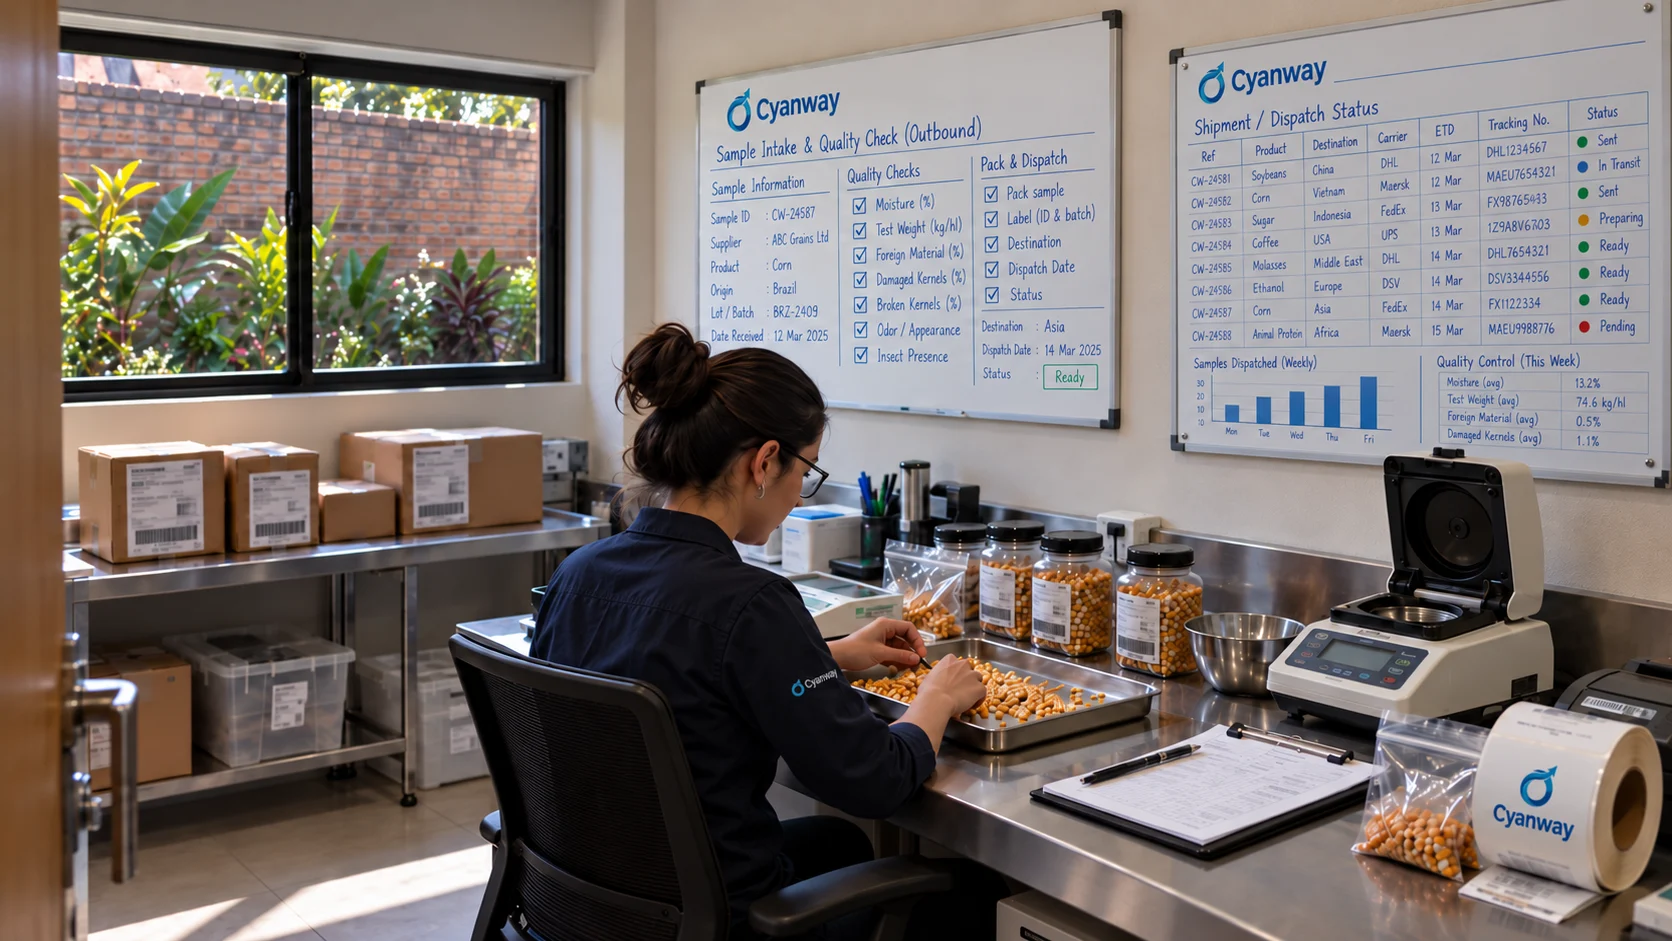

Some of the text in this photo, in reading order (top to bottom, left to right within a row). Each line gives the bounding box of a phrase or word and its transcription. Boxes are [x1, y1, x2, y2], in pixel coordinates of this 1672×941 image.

[1232, 61, 1327, 94] Cyanway
[757, 92, 840, 124] Cyanway
[1588, 106, 1618, 120] Status
[1195, 101, 1378, 138] Shipment / Dispatch Status
[1489, 114, 1549, 132] Tracking No.
[1435, 124, 1454, 137] ETD
[717, 115, 981, 166] Sample Intake & Quality Check (Outbound)
[1313, 136, 1358, 150] Destination
[1598, 134, 1617, 146] Sent
[1202, 150, 1215, 162] Ref
[1256, 143, 1287, 156] Product
[1487, 141, 1547, 158] DHL1234567
[981, 149, 1067, 171] Pack & Dispatch
[1381, 158, 1398, 168] DHL
[1431, 152, 1461, 164] 12 Mar
[1599, 156, 1641, 171] In Transit
[848, 162, 920, 186] Quality Checks
[1252, 169, 1286, 184] Soybeans
[1313, 165, 1334, 175] China
[1487, 166, 1555, 182] MAEU7654321
[712, 176, 804, 199] Sample Information
[1380, 179, 1409, 191] Maersk
[1431, 175, 1461, 187] 12 Mar
[1007, 182, 1064, 202] Pack sample
[1313, 187, 1345, 198] Vietnam
[1599, 185, 1618, 198] Sent
[876, 193, 935, 211] Moisture (%)
[1252, 193, 1270, 204] Corn
[1381, 204, 1406, 216] FedEx
[1431, 200, 1462, 212] 13 Mar
[711, 210, 750, 228] Sample ID
[1008, 204, 1095, 225] Label (ID & batch)
[1314, 209, 1351, 221] Indonesia
[1600, 212, 1643, 228] Preparing
[876, 216, 962, 238] Test Weight (kg/hl)
[1252, 215, 1275, 229] Sugar
[772, 230, 829, 245] ABC Grains Ltd
[1382, 229, 1398, 240] UPS
[1431, 225, 1462, 237] 13 Mar
[1008, 236, 1061, 250] Destination
[1252, 236, 1279, 248] Coffee
[1314, 234, 1331, 245] USA
[1488, 245, 1549, 259] DHL7654321
[1600, 238, 1629, 255] Ready
[876, 243, 964, 265] Foreign Material (%)
[1383, 253, 1400, 264] DHL
[1431, 250, 1462, 261] 14 Mar
[711, 260, 739, 273] Product
[772, 258, 792, 271] Corn
[1253, 260, 1286, 271] Molasses
[1314, 255, 1363, 268] Middle East
[1009, 259, 1075, 280] Dispatch Date
[1600, 265, 1629, 282] Ready
[877, 269, 966, 289] Damaged Kernels (%)
[1383, 278, 1400, 289] DSV
[1431, 275, 1463, 286] 14 Mar
[1488, 271, 1549, 284] DSV3344556
[711, 283, 733, 300] Origin
[773, 281, 796, 295] Brazil
[1253, 281, 1284, 293] Ethanol
[1314, 281, 1342, 294] Europe
[1011, 288, 1042, 300] Status
[1600, 292, 1629, 309] Ready
[877, 295, 961, 312] Broken Kernels (%)
[1314, 304, 1331, 314] Asia
[1383, 301, 1407, 313] FedEx
[1432, 300, 1463, 311] 14 Mar
[773, 305, 818, 318] BRZ-2409
[1253, 305, 1271, 316] Corn
[877, 322, 961, 341] Odor / Appearance
[982, 320, 1023, 332] Destination
[1044, 320, 1065, 333] Asia
[1314, 326, 1339, 338] Africa
[1382, 325, 1411, 337] Maersk
[1432, 325, 1463, 336] 15 Mar
[1600, 319, 1635, 336] Pending
[774, 329, 829, 342] 12 Mar 2025
[878, 348, 948, 363] Insect Presence
[982, 344, 1031, 359] Dispatch Date
[1045, 344, 1101, 356] 14 Mar 2025
[1194, 355, 1317, 372] Samples Dispatched (Weekly)
[1437, 353, 1581, 371] Quality Control (This Week)
[983, 367, 1011, 379] Status
[1056, 369, 1084, 387] Ready
[1575, 378, 1600, 388] 13.2%
[1577, 397, 1626, 411] 74.6 kg/hl
[1448, 411, 1475, 425] Foreign
[1479, 413, 1511, 423] Material
[1576, 416, 1601, 427] 0.5%
[1577, 436, 1599, 446] 1.1%
[805, 669, 838, 688] Cyanway
[1494, 804, 1574, 842] Cyanway
